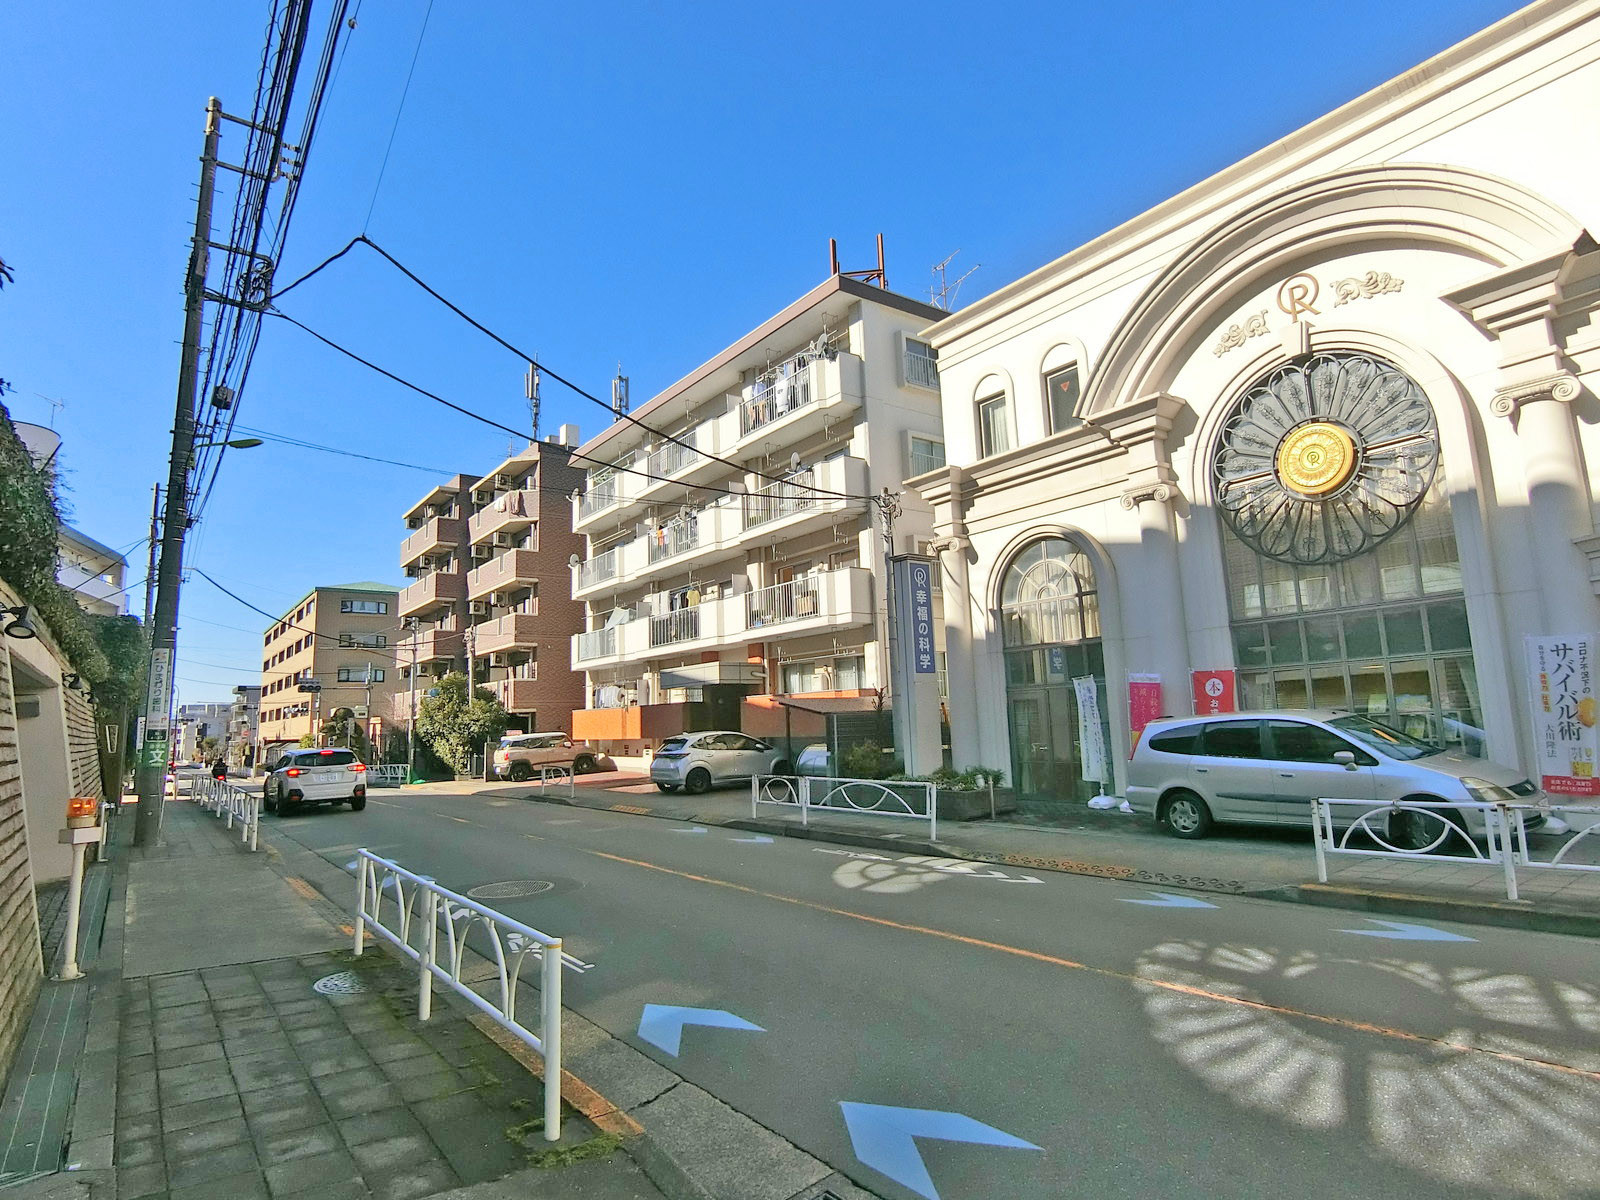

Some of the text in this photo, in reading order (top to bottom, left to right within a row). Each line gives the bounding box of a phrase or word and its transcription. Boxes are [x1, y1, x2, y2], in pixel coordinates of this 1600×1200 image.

[916, 590, 931, 669] 幸福の科学
[1209, 681, 1221, 694] 本
[1550, 643, 1582, 741] サバイバル術
[1578, 642, 1591, 694] コロナ不況下の
[149, 749, 165, 763] 文
